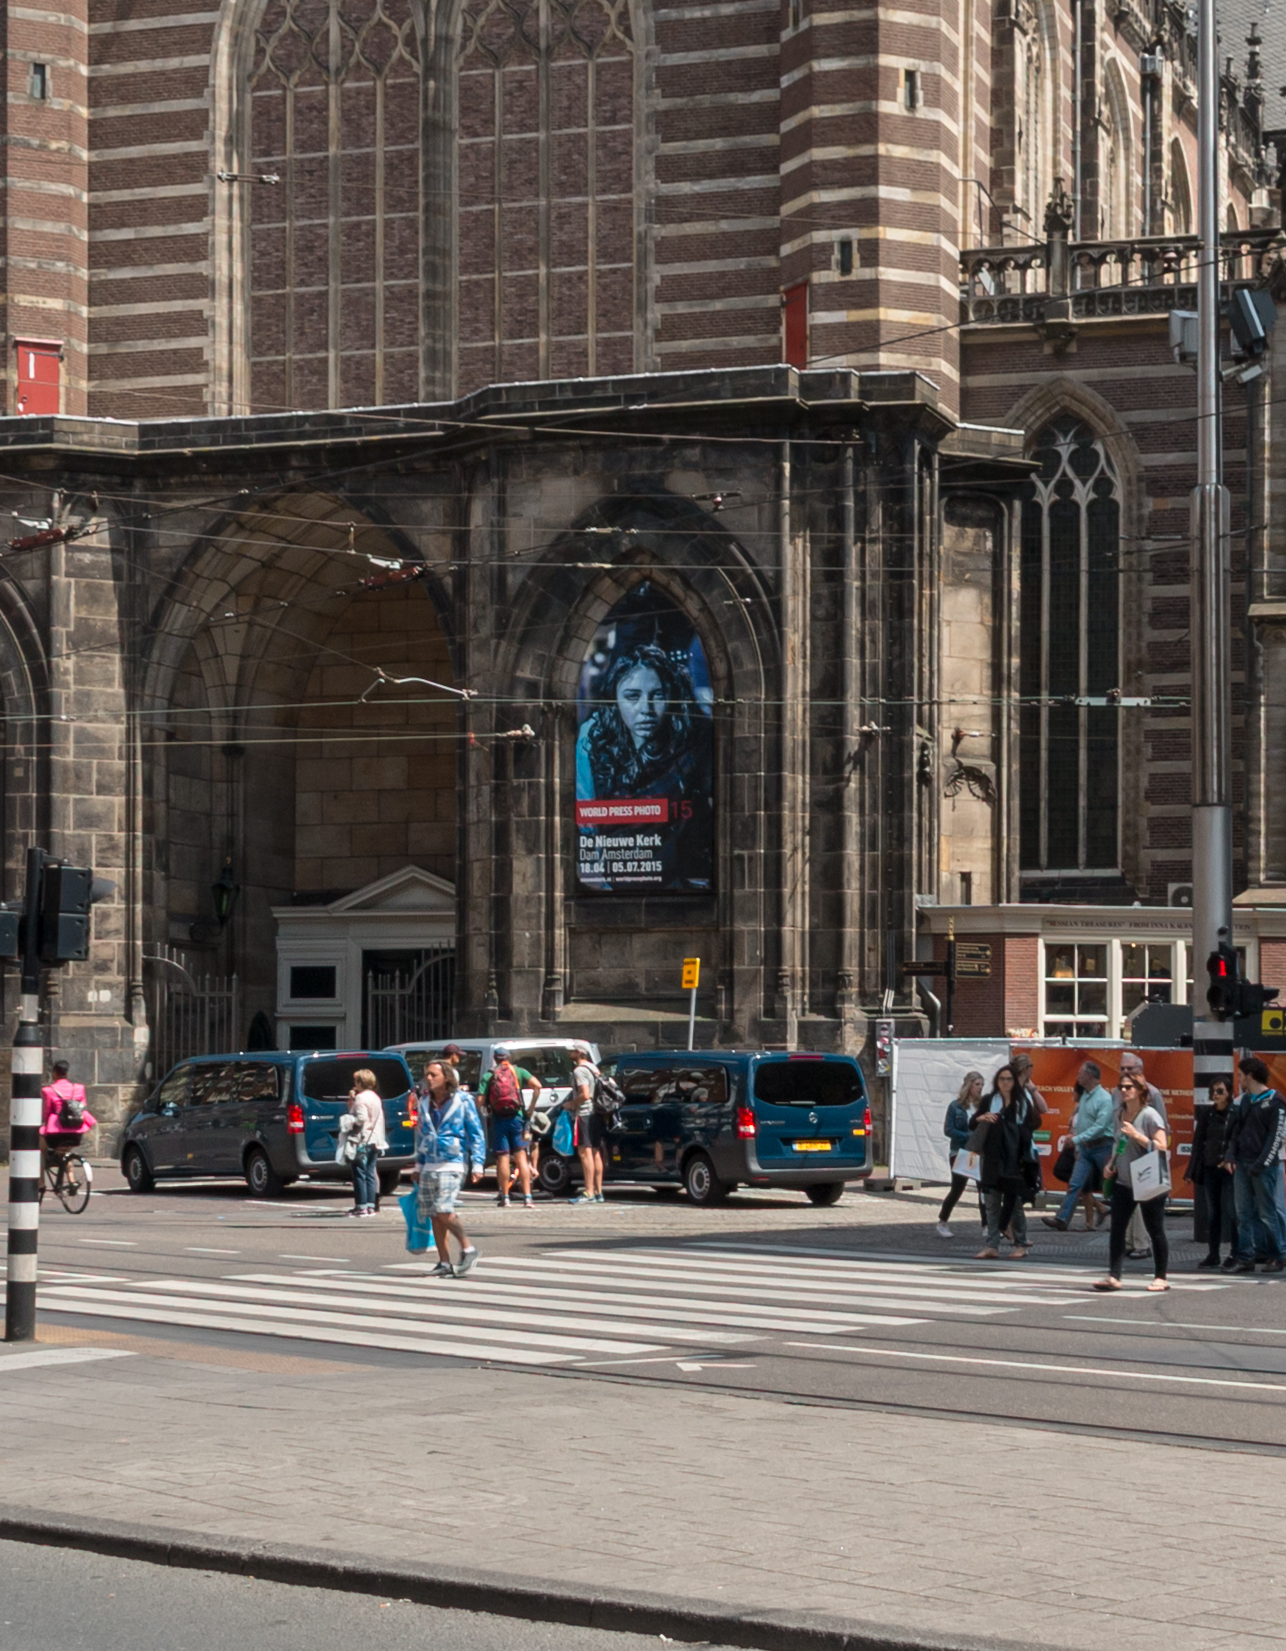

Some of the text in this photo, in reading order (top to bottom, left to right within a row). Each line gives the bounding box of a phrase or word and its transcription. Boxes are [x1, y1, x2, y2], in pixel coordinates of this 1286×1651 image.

[579, 805, 661, 817] WORLD PRESS PHOTO
[671, 800, 693, 819] 15
[579, 833, 662, 848] De Nieuwe Kerk
[579, 848, 653, 860] Dam Amsterdam
[580, 860, 662, 873] 18.04 05.07.2015
